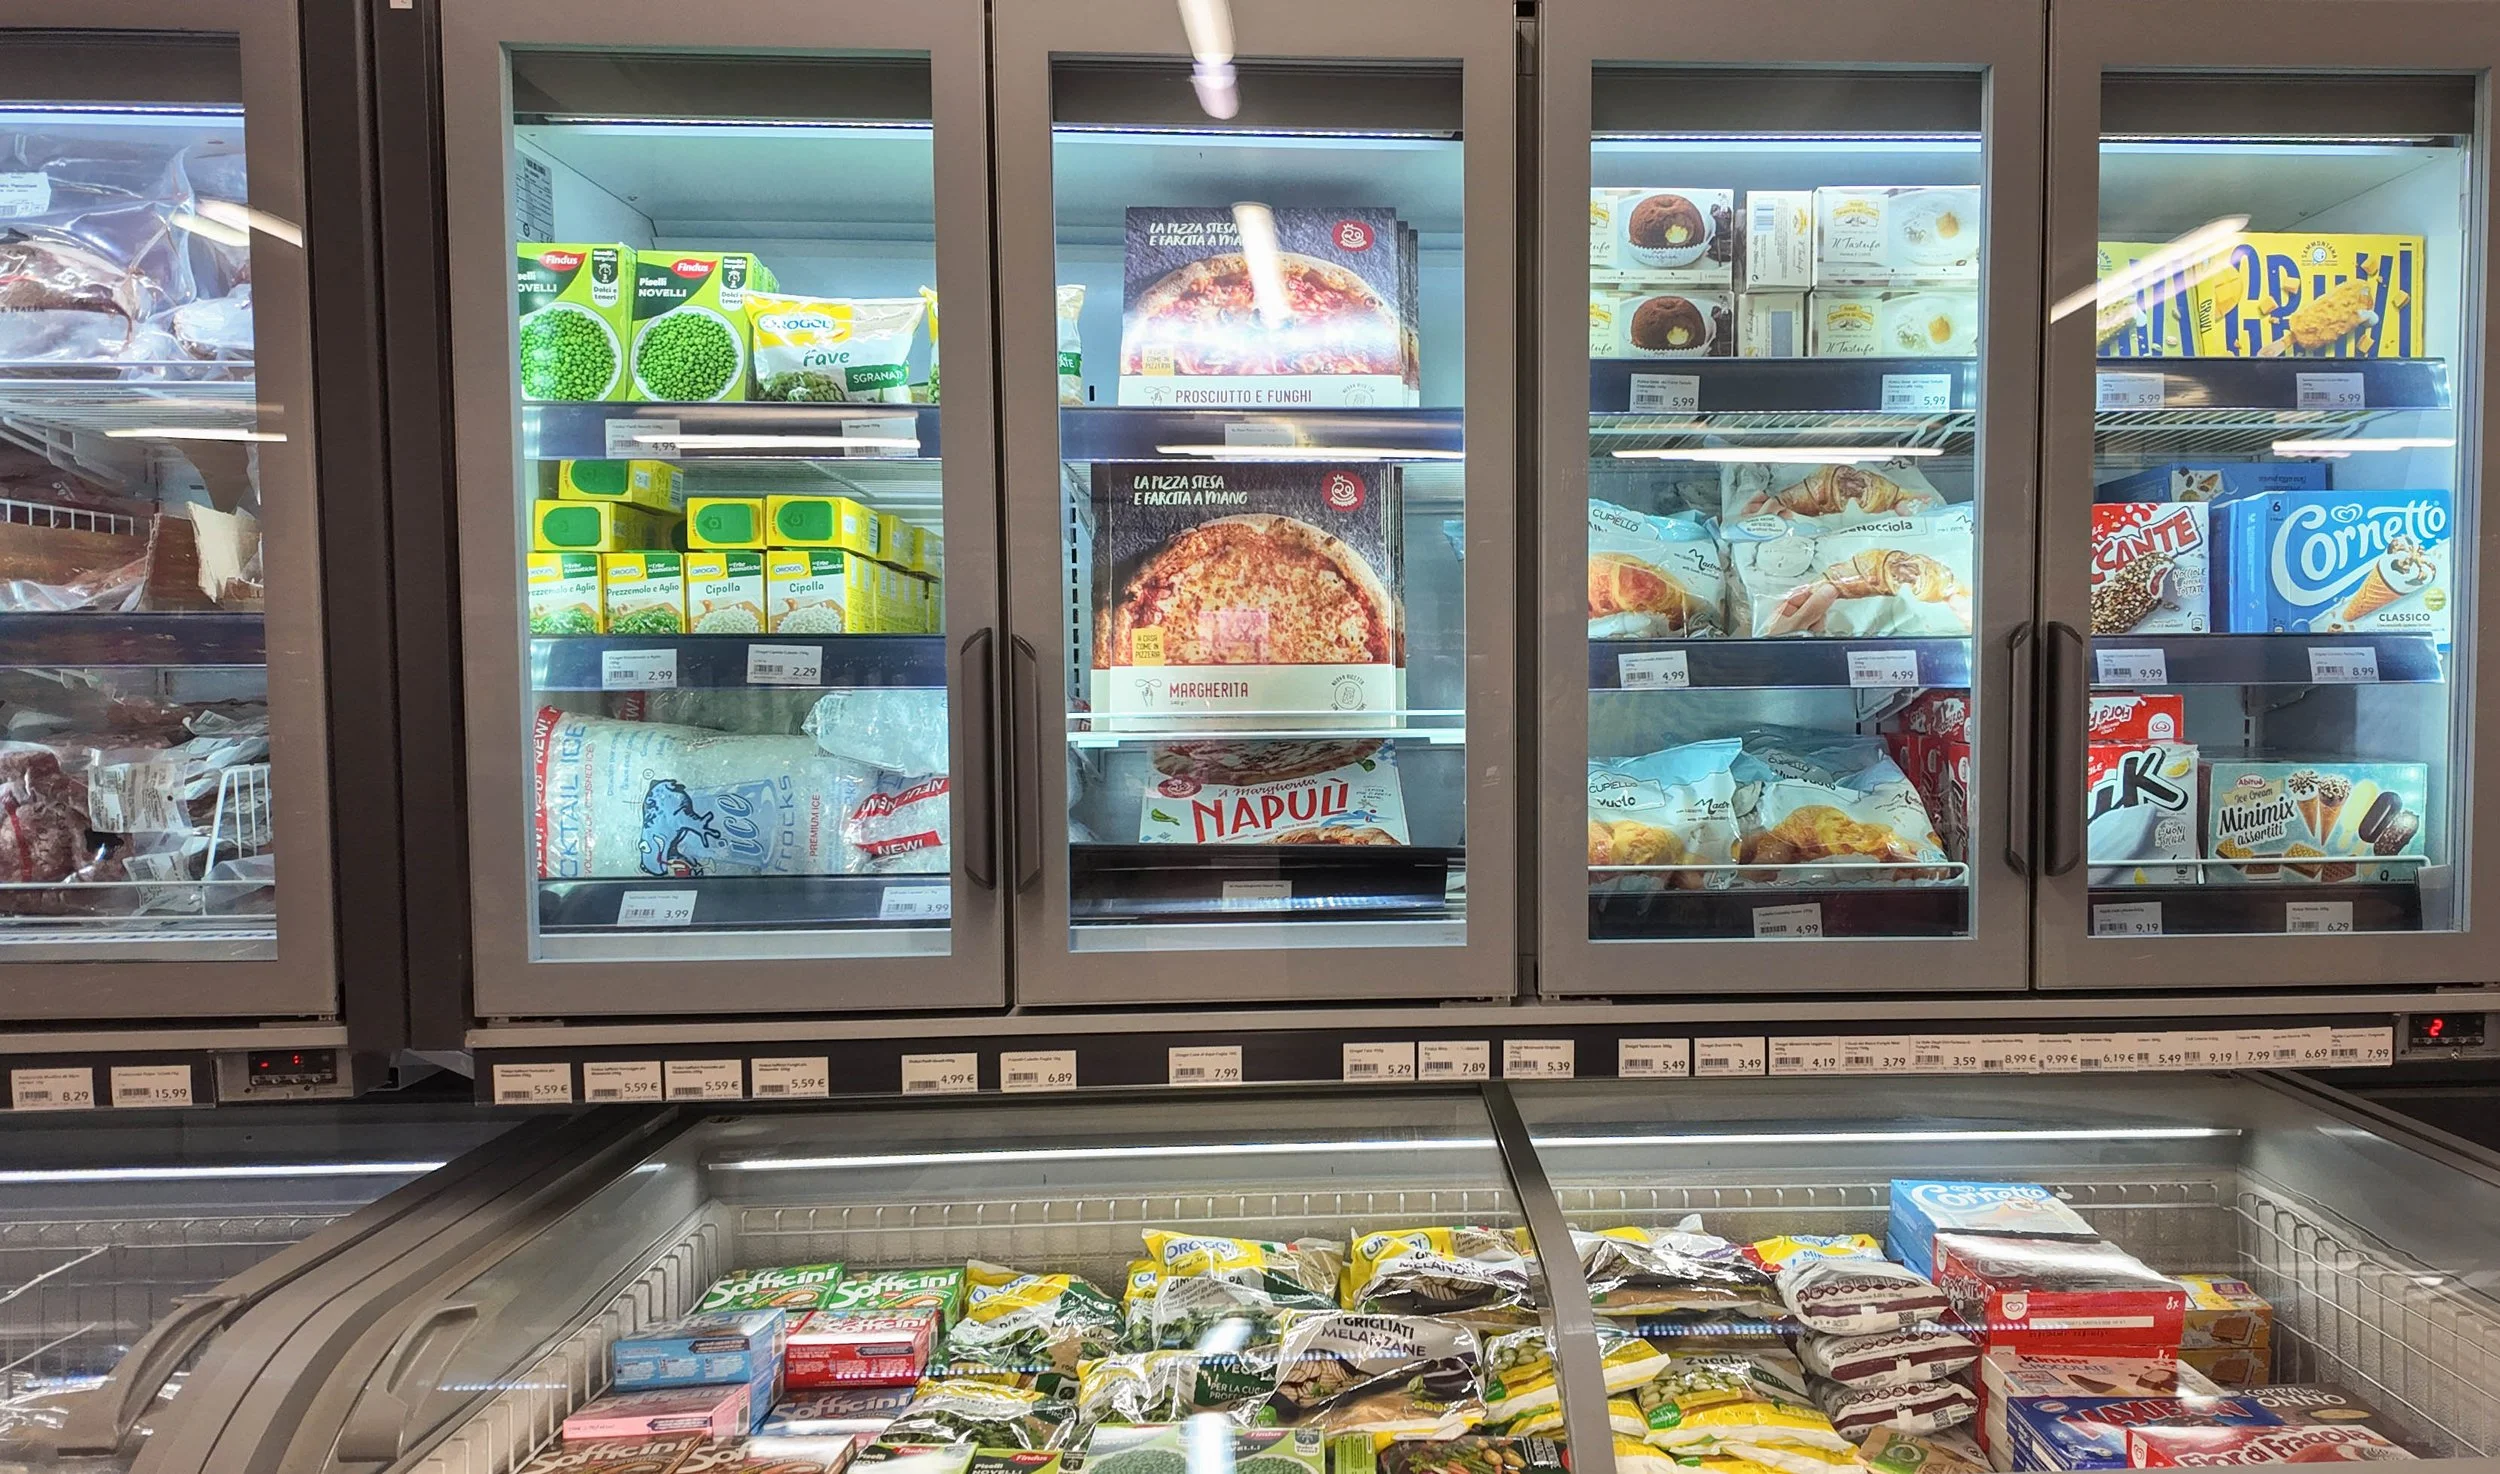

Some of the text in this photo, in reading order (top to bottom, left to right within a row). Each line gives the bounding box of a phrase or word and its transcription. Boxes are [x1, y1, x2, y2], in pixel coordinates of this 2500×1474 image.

[1150, 222, 1238, 236] LA PIZZA STESA
[1150, 236, 1157, 246] E
[1159, 234, 1206, 247] FARCITA
[1842, 237, 1881, 252] Tartufo
[2300, 240, 2338, 259] SAMMONTANA
[545, 254, 578, 265] Findus
[677, 262, 709, 273] Findus
[639, 277, 668, 287] Piselli
[518, 284, 557, 293] OVELLI
[593, 286, 610, 294] Dolci
[638, 288, 687, 298] NOVELLI
[594, 293, 616, 301] teneri
[1837, 341, 1874, 356] Tartufo
[803, 349, 850, 367] Fave
[1176, 389, 1312, 404] PROSCIUTTO E FUNGHI
[1924, 396, 1946, 406] 5,99
[2139, 393, 2161, 404] 5,99
[2339, 393, 2361, 403] 5,99
[1672, 397, 1695, 408] 5,99
[652, 442, 676, 452] 4,99
[1134, 475, 1224, 490] LA PIZZA STESA
[1134, 491, 1248, 506] E FARCITA A MANO
[2272, 502, 2281, 512] 6
[1592, 508, 1639, 532] CUPIELLO
[1857, 520, 1913, 533] Nocciola
[2272, 500, 2446, 606] Cornetto
[575, 583, 596, 595] Aglio
[607, 586, 649, 597] Prezzemolo
[659, 583, 680, 595] Aglio
[705, 583, 741, 596] Cipolla
[789, 581, 824, 594] Cipolla
[2379, 613, 2430, 622] CLASSICO
[1144, 634, 1158, 642] CASA
[1135, 650, 1160, 659] PIZZERIA
[648, 670, 673, 681] 2,99
[1662, 671, 1685, 682] 4,99
[1891, 670, 1914, 681] 4,99
[2140, 669, 2162, 678] 9,99
[2352, 667, 2374, 677] 8,99
[1169, 682, 1249, 699] MARGHERITA
[534, 719, 547, 763] NEW!
[1233, 778, 1319, 798] Margherita
[1588, 781, 1638, 794] CUPIELLO
[2249, 787, 2273, 801] Cream
[560, 724, 586, 877] CKTAIL ICE
[860, 794, 897, 812] NEW!
[1192, 777, 1349, 844] NAPULÌ
[2218, 797, 2294, 834] Minimix
[717, 793, 763, 856] ice
[810, 794, 821, 857] PREMIUM ICE
[2238, 821, 2284, 847] assortiti
[877, 838, 924, 855] NEW!
[664, 908, 688, 919] 3,99
[926, 902, 949, 914] 3,99
[1795, 924, 1818, 935] 4,99
[2136, 923, 2158, 933] 9,19
[2328, 922, 2349, 931] 6,29
[2005, 1053, 2037, 1064] 8,99 €
[2104, 1053, 2135, 1063] 6,19 €
[2159, 1053, 2181, 1064] 5,49
[2209, 1052, 2232, 1063] 9,19
[2248, 1051, 2270, 1061] 7,99
[2305, 1048, 2328, 1058] 6,69
[2367, 1049, 2389, 1058] 7,99
[1738, 1059, 1761, 1069] 3,49
[1812, 1058, 1836, 1068] 4,19
[1883, 1057, 1906, 1067] 3,79
[1953, 1056, 1976, 1066] 3,59
[2046, 1054, 2078, 1064] 9,99 €
[1388, 1064, 1411, 1075] 5,29
[1462, 1062, 1486, 1073] 7,89
[1547, 1061, 1570, 1072] 5,39
[1662, 1060, 1686, 1071] 5,49
[1047, 1073, 1072, 1083] 6,89
[1214, 1068, 1238, 1079] 7,99
[791, 1079, 825, 1089] 5,59 €
[941, 1074, 975, 1085] 4,99 €
[534, 1085, 568, 1095] 5,59 €
[624, 1082, 658, 1093] 5,59 €
[705, 1081, 739, 1091] 5,59 €
[63, 1091, 89, 1101] 8,29
[155, 1088, 187, 1099] 15,99
[1911, 1184, 2048, 1208] Cornetto
[702, 1266, 839, 1310] Sofficini
[829, 1271, 958, 1310] Sofficini
[825, 1315, 928, 1334] Sofficini
[1347, 1317, 1414, 1339] GRIGLIATI
[1321, 1327, 1427, 1358] MELANZANE
[2021, 1355, 2089, 1366] Kinder
[2018, 1362, 2112, 1374] CHOCOLATE
[1210, 1383, 1241, 1393] PER LA
[2245, 1387, 2298, 1399] COPPA
[2257, 1393, 2347, 1409] ONNO
[772, 1394, 918, 1420] Sofficini
[2060, 1397, 2254, 1440] MAXIBON
[2265, 1424, 2376, 1458] Fragola
[530, 1437, 691, 1474] Sofficini
[858, 1453, 886, 1461] Piselli
[1016, 1454, 1049, 1463] Findus
[974, 1463, 1004, 1471] Piselli
